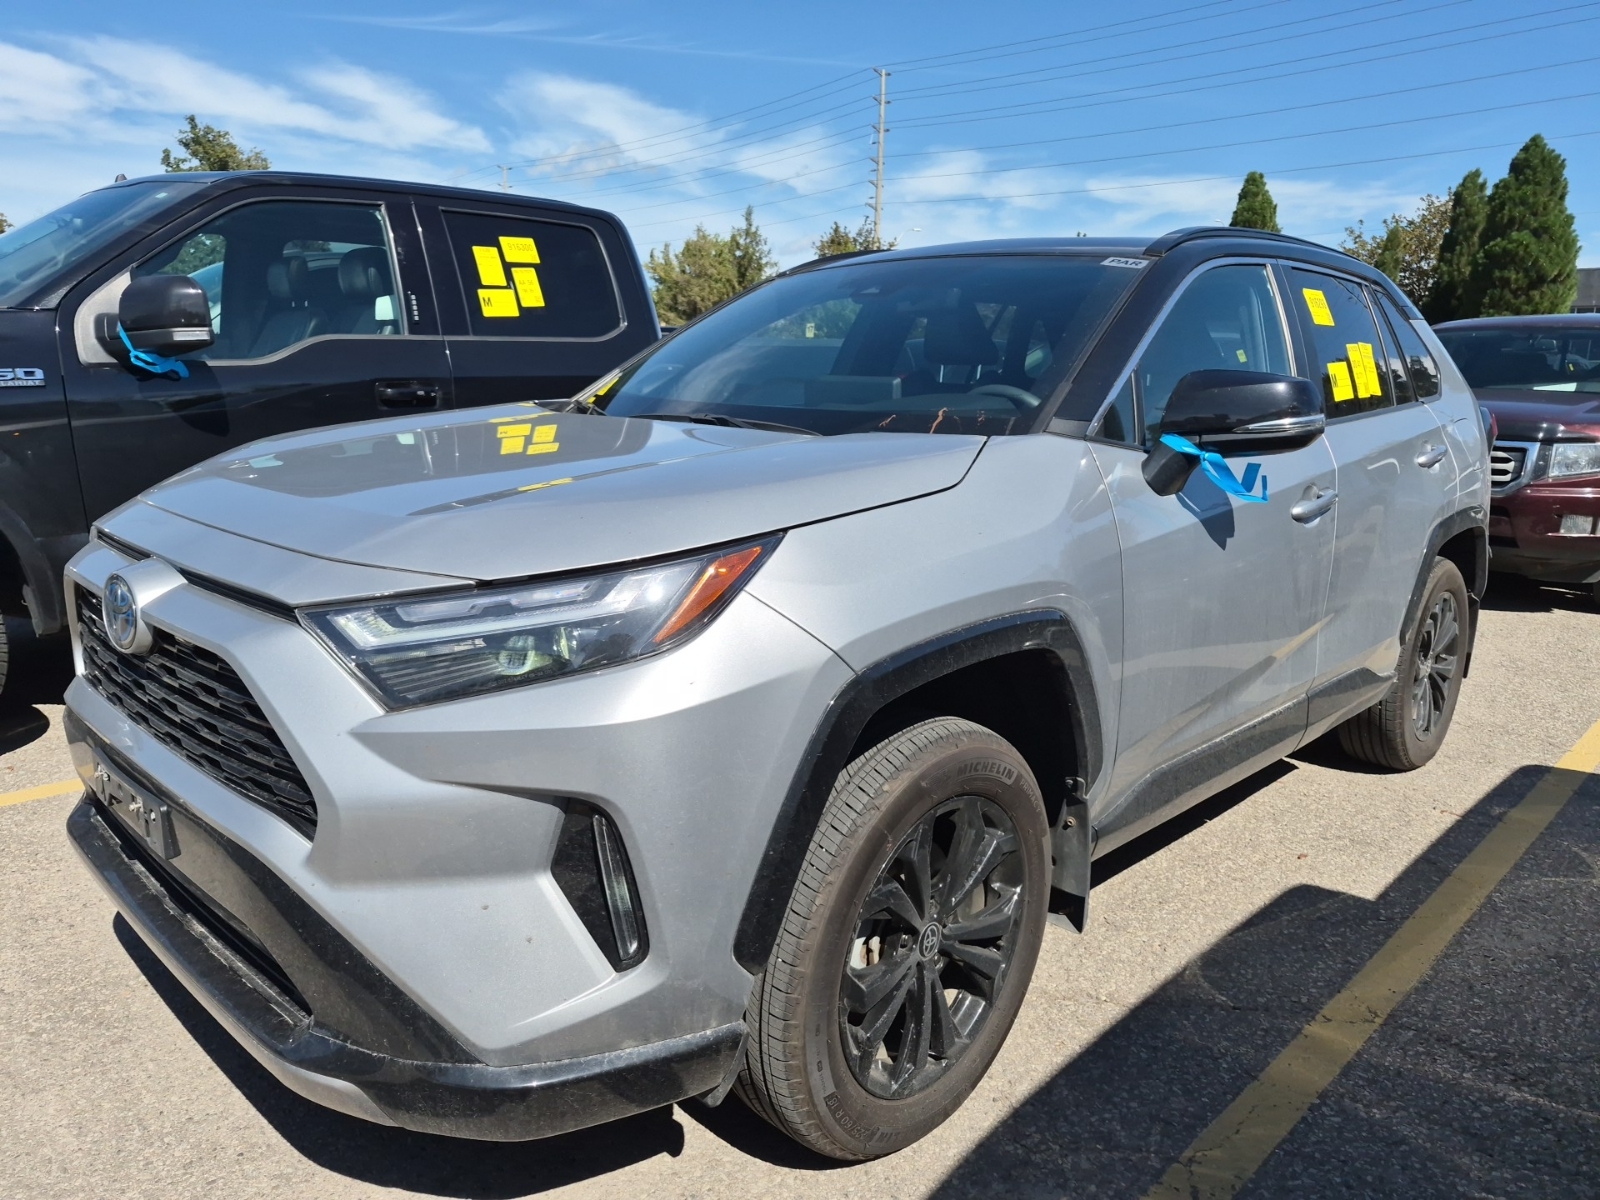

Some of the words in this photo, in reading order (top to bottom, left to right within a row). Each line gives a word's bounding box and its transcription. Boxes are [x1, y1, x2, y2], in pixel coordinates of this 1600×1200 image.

[482, 297, 493, 307] M
[1331, 373, 1339, 388] M
[957, 762, 1015, 780] MICHELIN
[1019, 779, 1042, 814] PRIMACY
[828, 1097, 838, 1109] 18
[835, 1109, 845, 1118] R
